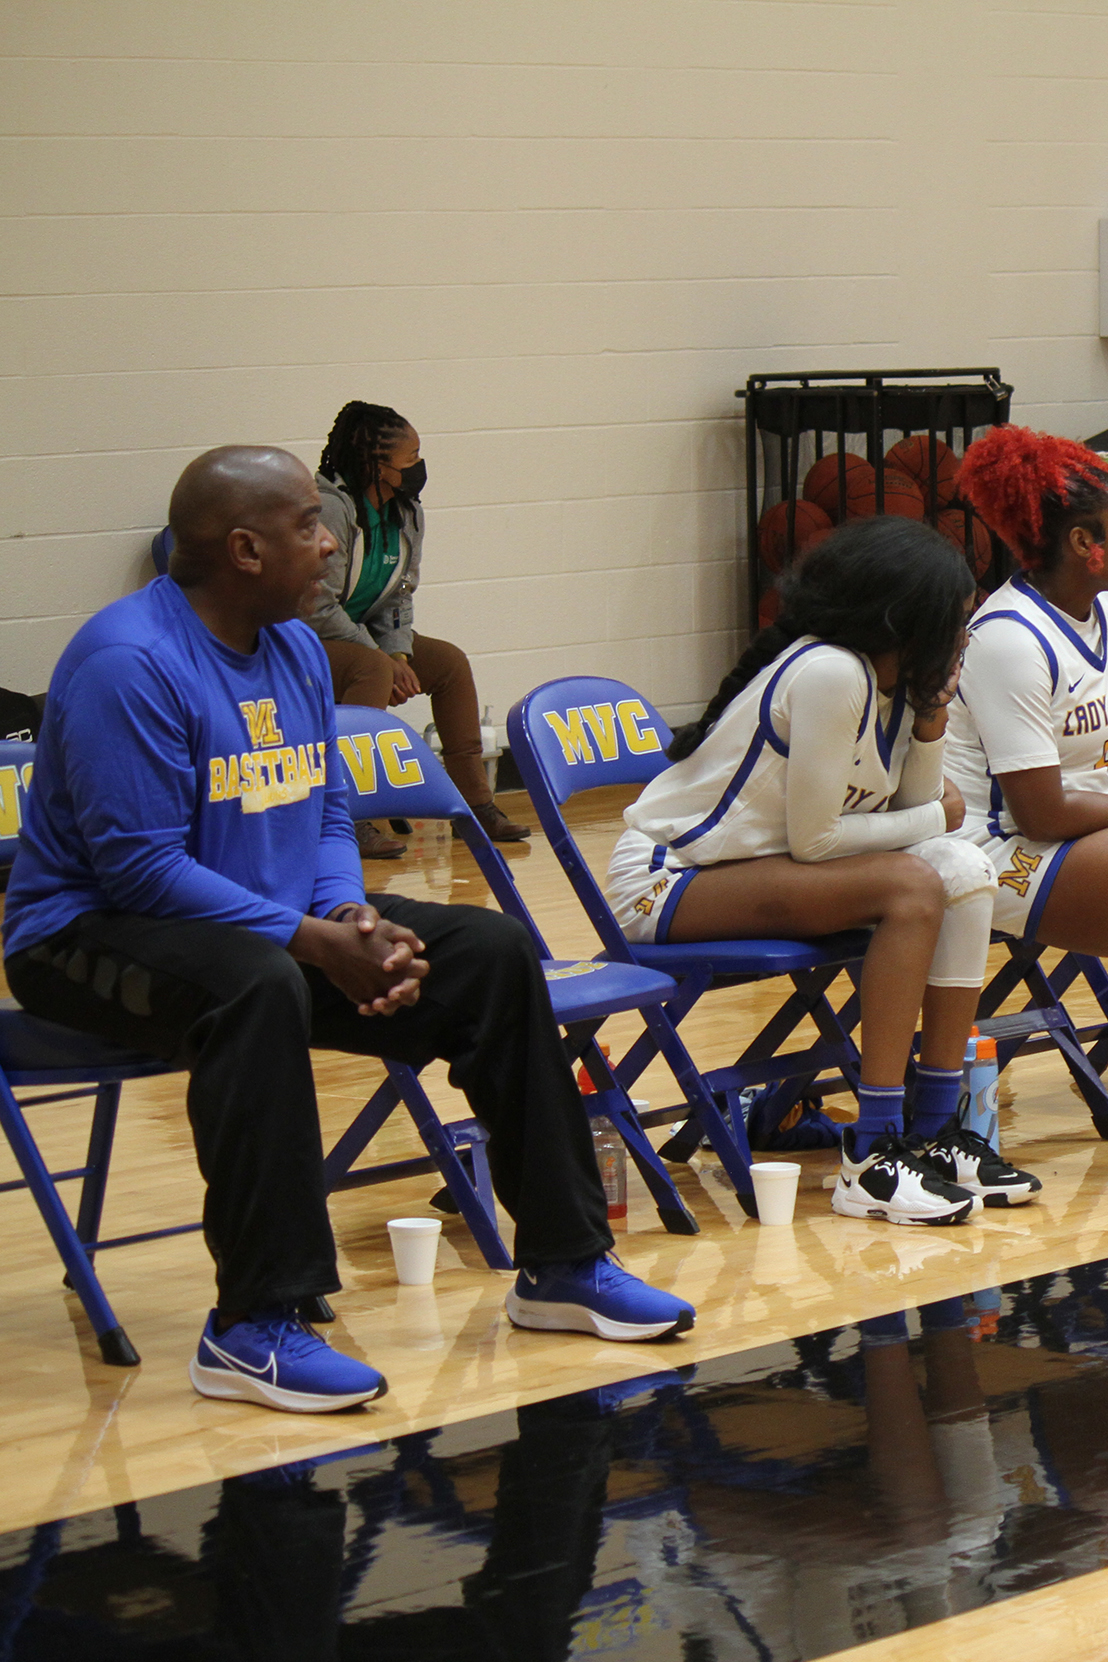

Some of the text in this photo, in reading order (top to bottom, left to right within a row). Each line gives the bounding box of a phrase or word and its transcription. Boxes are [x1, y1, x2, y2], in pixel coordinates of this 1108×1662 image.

[239, 698, 284, 749] M
[542, 699, 662, 765] MVC
[1062, 694, 1108, 737] LADY
[337, 728, 424, 795] VC
[998, 846, 1043, 898] M
